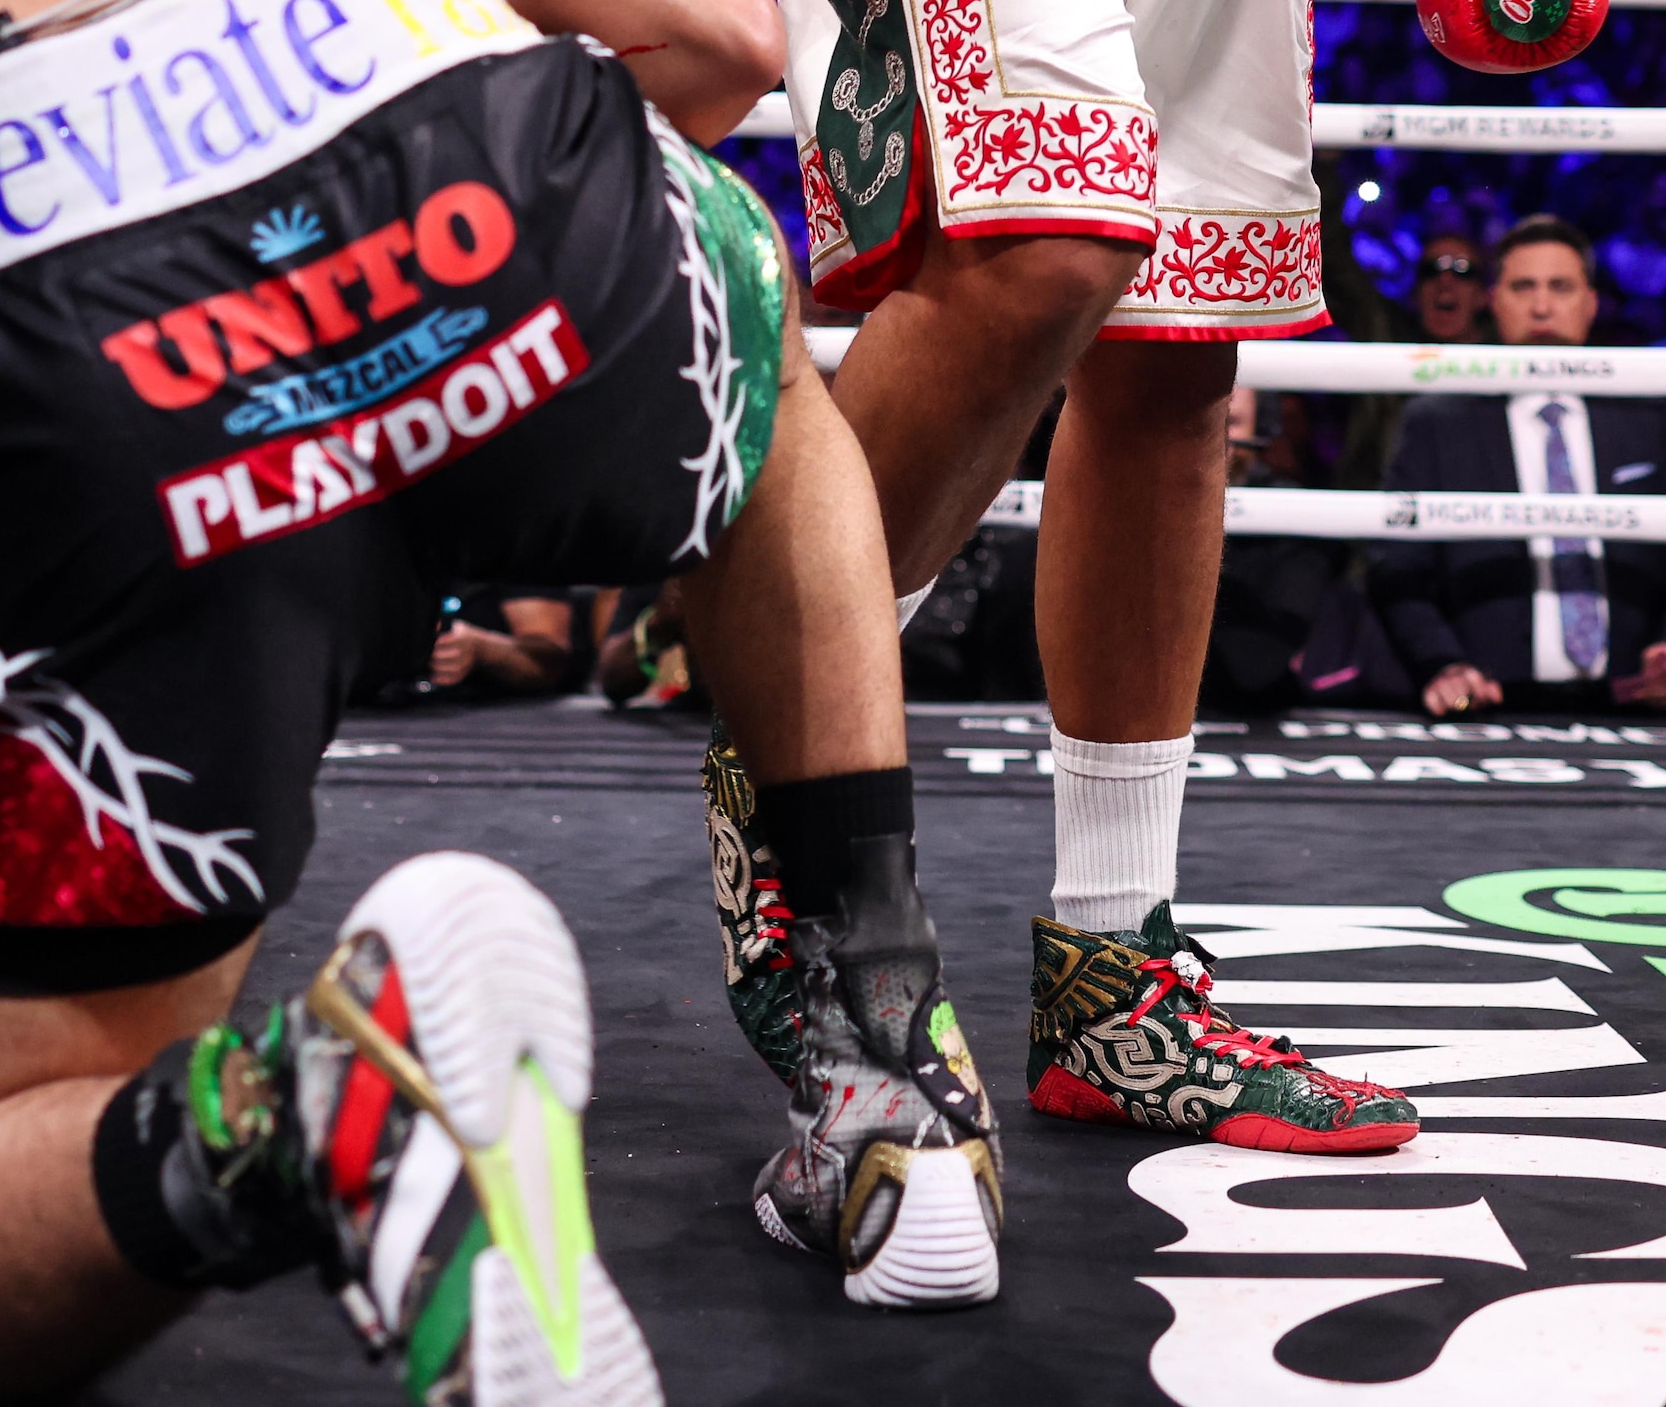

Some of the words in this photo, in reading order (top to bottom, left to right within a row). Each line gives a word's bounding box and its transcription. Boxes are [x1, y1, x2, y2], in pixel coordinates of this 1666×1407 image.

[1412, 352, 1615, 381] DRAFTKINGS
[166, 303, 569, 560] PLAYDOIT
[944, 747, 1583, 784] TMAS
